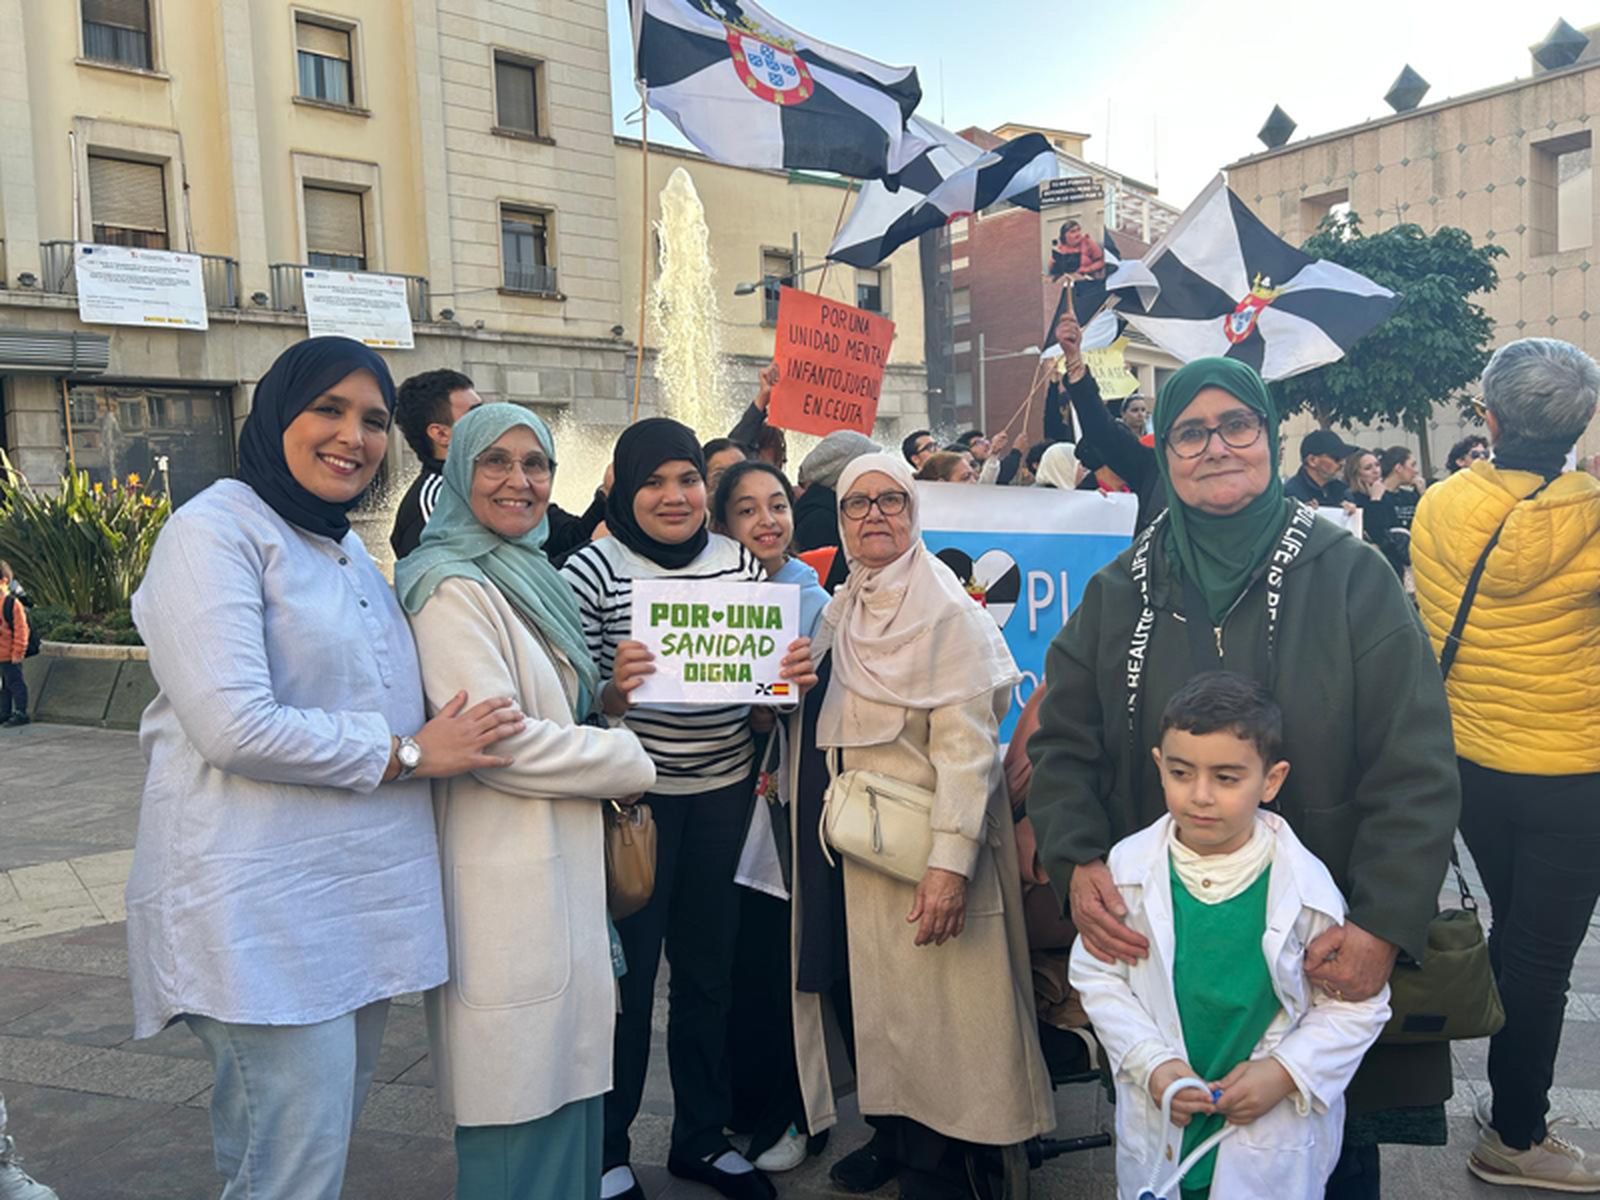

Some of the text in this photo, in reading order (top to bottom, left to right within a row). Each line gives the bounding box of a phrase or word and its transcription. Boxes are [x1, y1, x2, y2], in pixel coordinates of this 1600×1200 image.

[821, 305, 870, 335] POR UNA
[789, 324, 839, 353] UNIDAD
[803, 394, 863, 424] EN CEUTA
[1273, 527, 1307, 564] LIFE
[650, 603, 783, 629] POR UNA
[661, 632, 775, 660] SANIDAD
[684, 663, 752, 682] DIGNA
